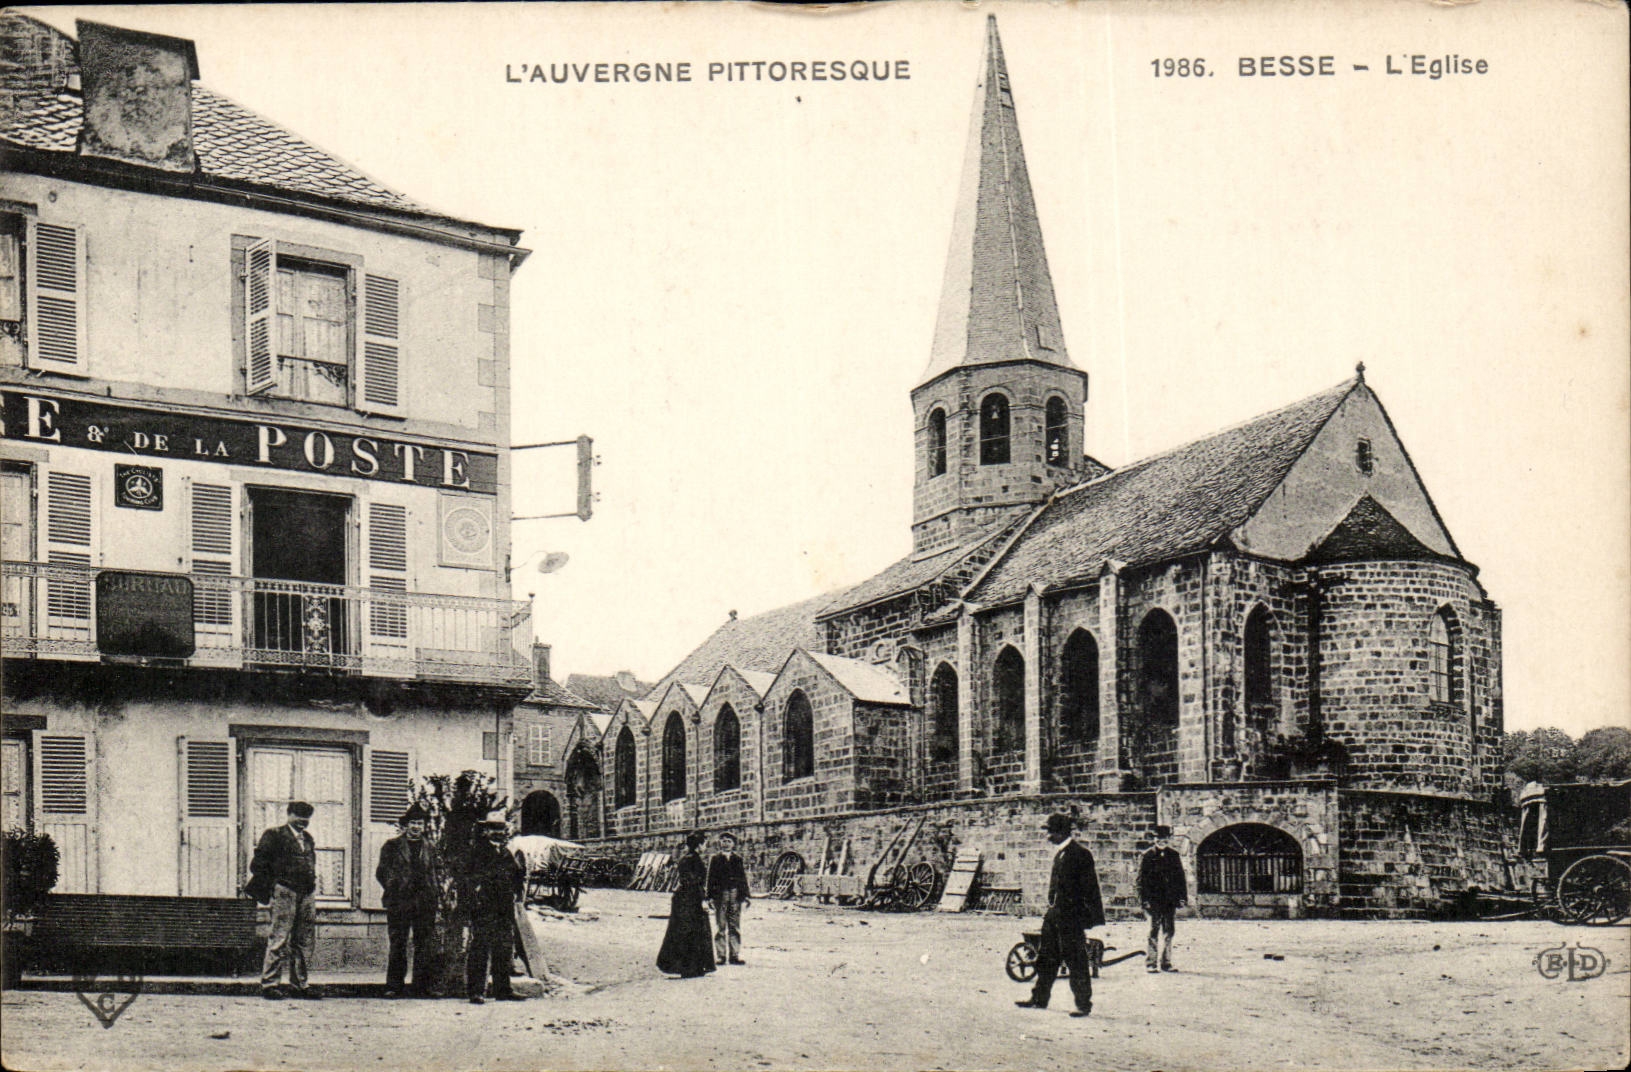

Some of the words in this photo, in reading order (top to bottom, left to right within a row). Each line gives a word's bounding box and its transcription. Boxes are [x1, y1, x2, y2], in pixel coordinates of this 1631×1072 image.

[0, 393, 61, 443] E
[133, 431, 169, 451] DE
[195, 438, 229, 457] LA
[255, 425, 470, 489] POSTE
